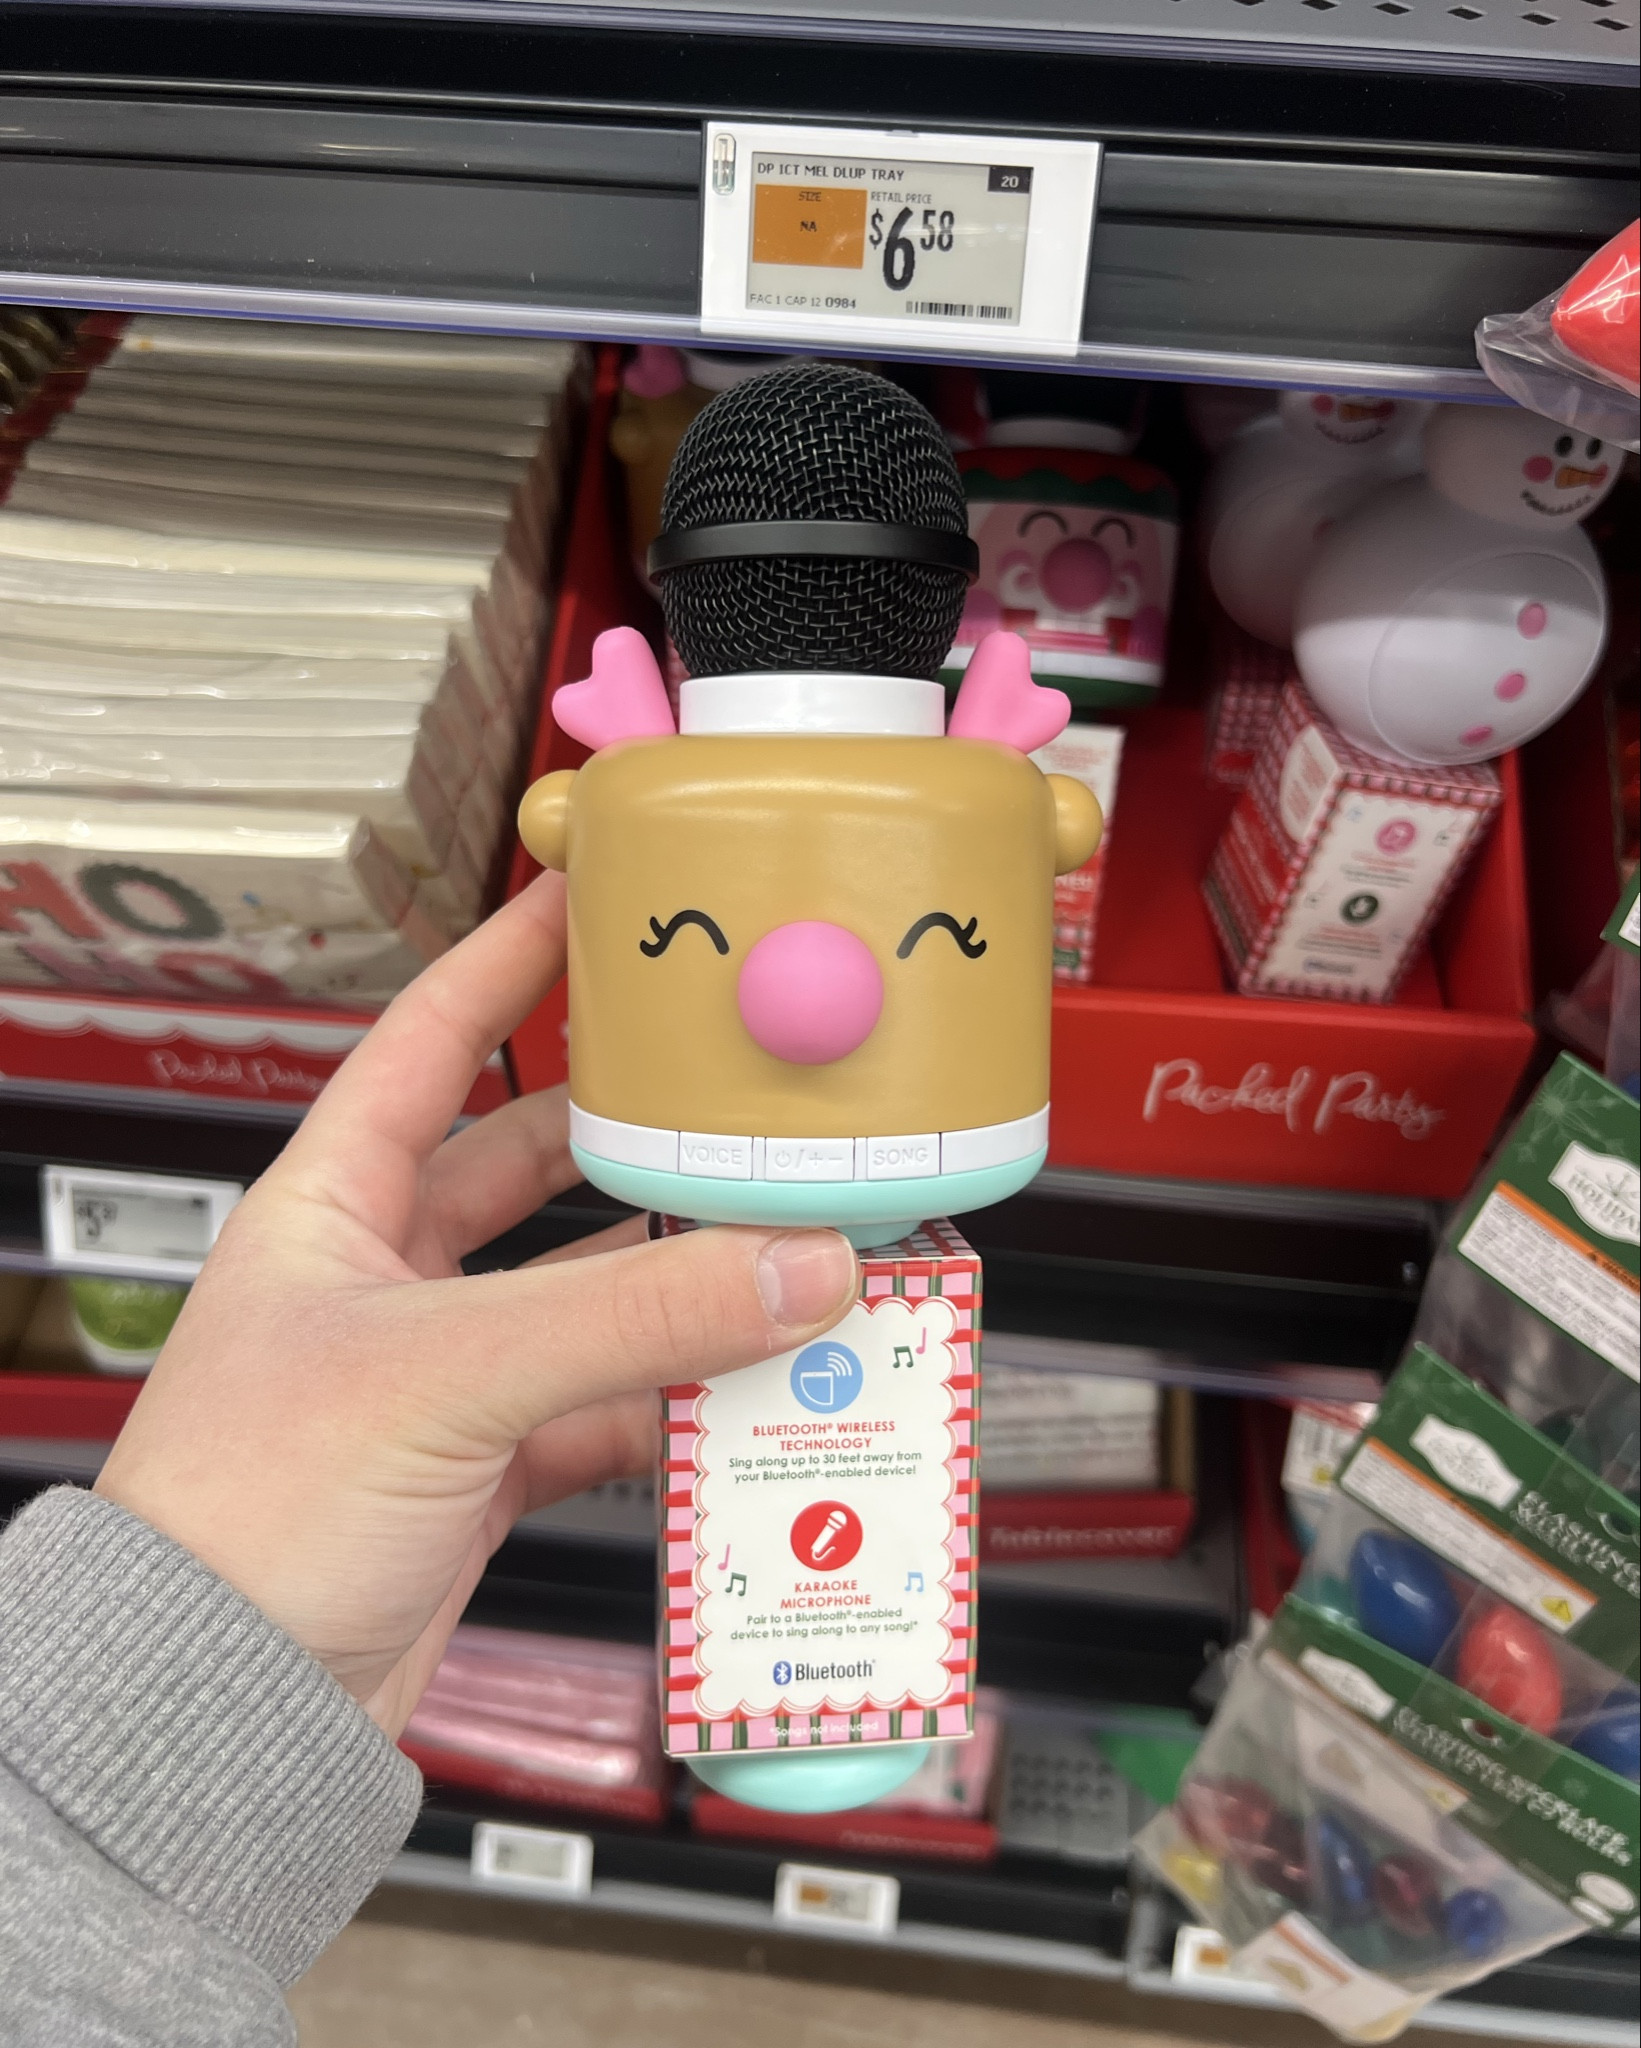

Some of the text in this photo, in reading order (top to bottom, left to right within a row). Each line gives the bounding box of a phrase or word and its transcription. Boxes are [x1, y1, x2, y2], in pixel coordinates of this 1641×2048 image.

[757, 163, 905, 181] DP ICT MEL DLUP TRAY
[1000, 175, 1020, 188] 20
[798, 191, 822, 202] SIZE
[870, 191, 932, 204] RETAIL PRICE
[800, 221, 818, 232] NA
[749, 293, 772, 305] FAC
[784, 296, 807, 305] CAP
[810, 297, 821, 307] 12
[825, 297, 856, 309] 0984
[682, 1144, 743, 1166] VOICE
[872, 1147, 929, 1167] SONG
[837, 1420, 896, 1434] WIRELESS
[780, 1437, 872, 1451] TECHNOLOGY
[729, 1451, 922, 1469] Sing along up to 30 feet away from
[734, 1472, 760, 1485] your
[874, 1464, 917, 1477] device!
[794, 1580, 858, 1593] KARAOKE
[780, 1594, 871, 1610] MICROPHONE
[746, 1614, 767, 1625] Pair
[770, 1614, 782, 1624] to
[785, 1615, 792, 1623] a
[730, 1628, 769, 1640] device
[772, 1627, 783, 1638] to
[786, 1626, 808, 1638] sing
[811, 1624, 843, 1637] along
[846, 1623, 857, 1633] to
[859, 1623, 881, 1634] any
[811, 1723, 828, 1734] not
[830, 1721, 879, 1734] included
